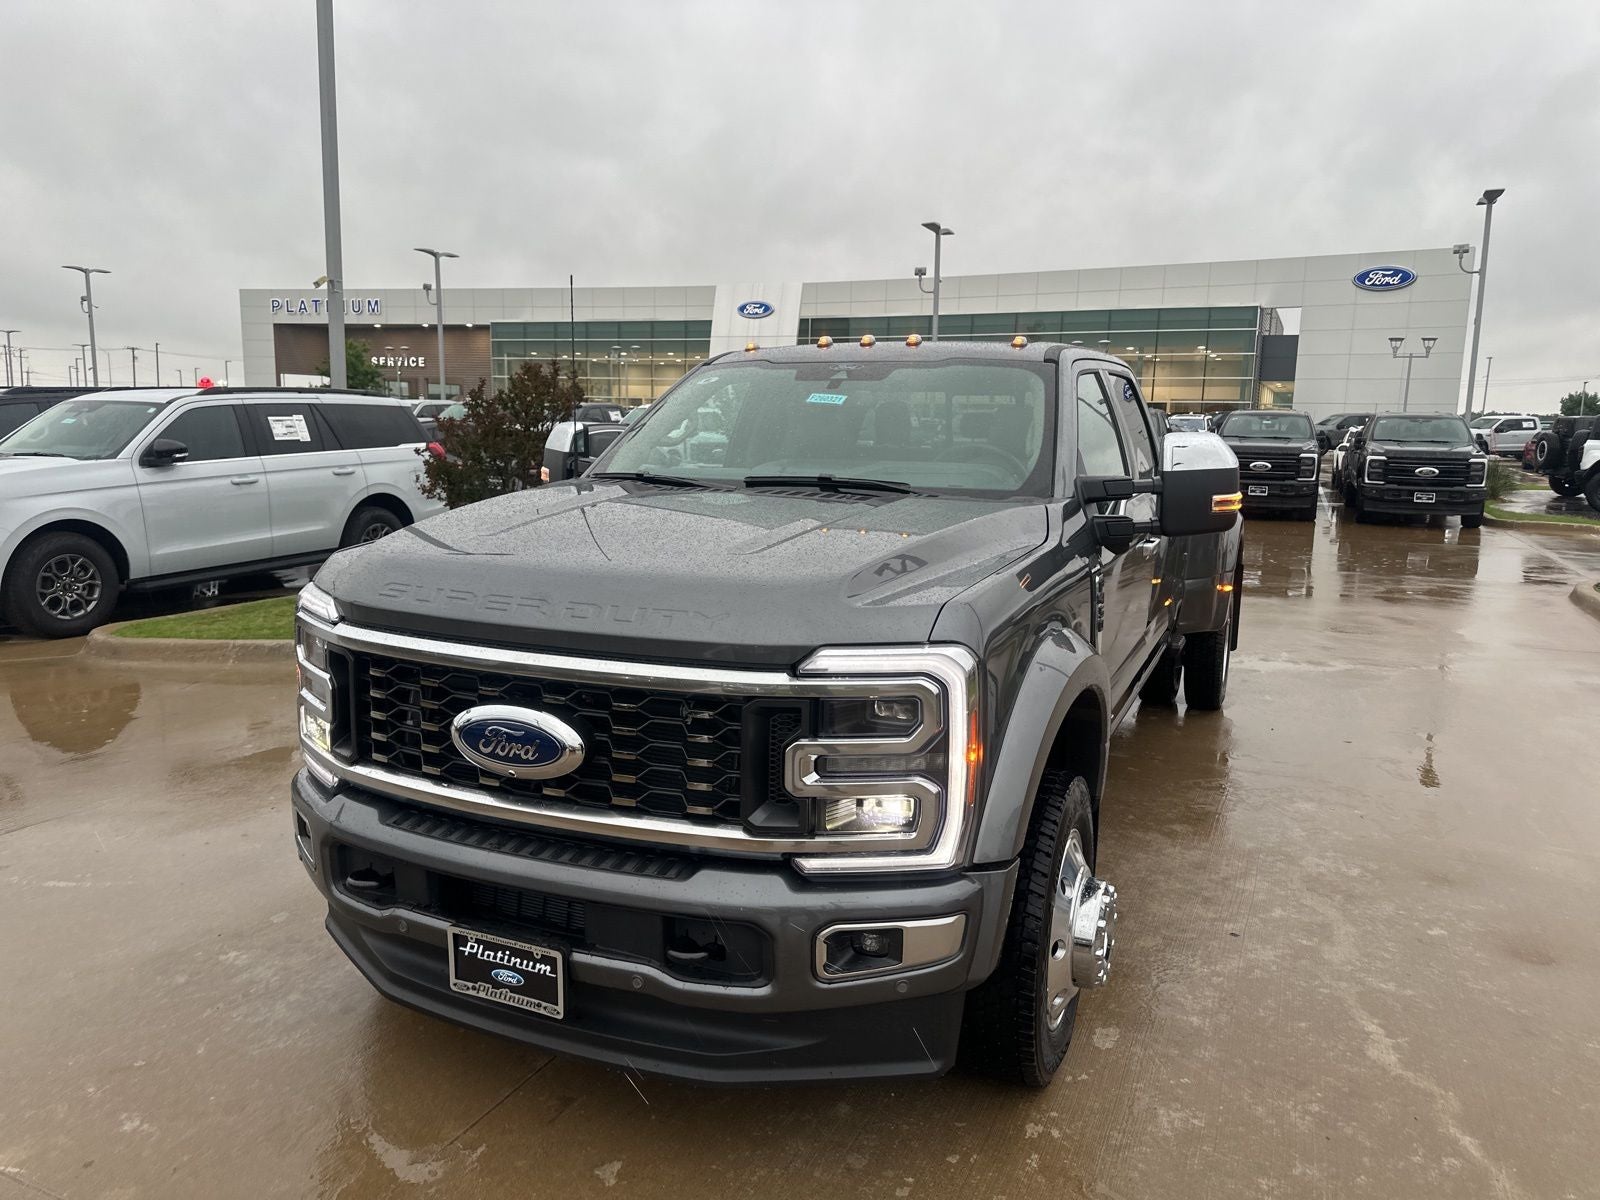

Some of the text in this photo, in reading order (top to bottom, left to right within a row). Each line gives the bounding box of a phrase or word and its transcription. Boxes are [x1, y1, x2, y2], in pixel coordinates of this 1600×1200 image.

[1364, 270, 1403, 285] Ford
[271, 299, 380, 313] PLATIUM
[743, 303, 764, 314] Ford
[371, 356, 425, 367] SERVICE
[378, 581, 732, 629] SUPER DUTY
[479, 725, 541, 761] Ford
[459, 941, 557, 978] Platinum
[497, 971, 518, 984] Ford
[475, 981, 538, 1010] Platinum
